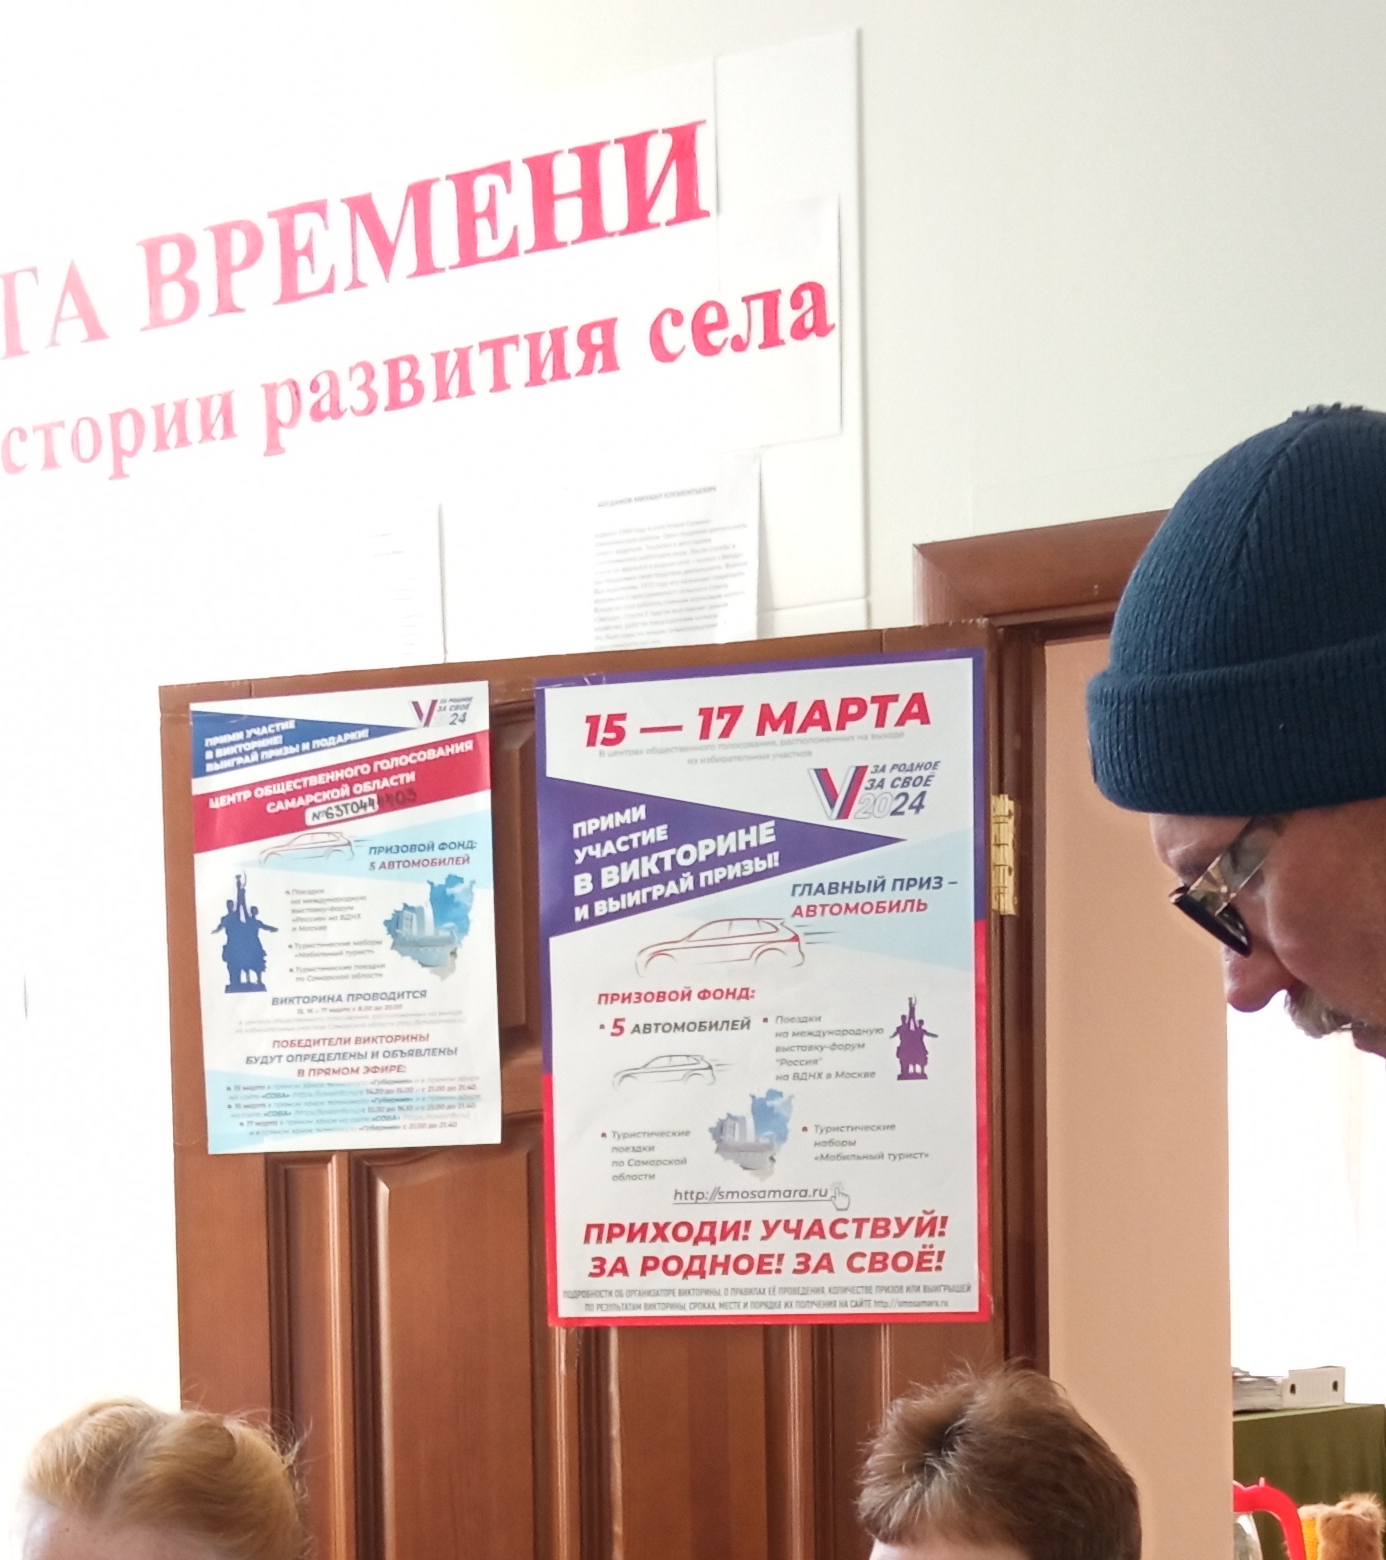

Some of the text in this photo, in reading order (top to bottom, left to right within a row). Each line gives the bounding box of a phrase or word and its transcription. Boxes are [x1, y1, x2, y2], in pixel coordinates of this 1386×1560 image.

[135, 118, 712, 334] ВРЕМЕНИ
[261, 314, 621, 457] развития
[647, 279, 838, 365] села
[585, 691, 931, 748] 15 17 МАРТА
[204, 719, 296, 748] ПРИМИ УЧАСТИЕ
[205, 735, 283, 761] В ВИКТОРИНЕ!
[205, 728, 369, 773] ВЫИГРАЙ ПРИЗЫ И ПОДАРКИ!
[645, 741, 716, 757] общественного
[780, 733, 856, 748] расположенных
[871, 730, 905, 742] выходе
[208, 740, 474, 810] ЦЕНТР ОБЩЕСТВЕННОГО ГОЛОСОВАНИЯ
[870, 760, 941, 775] ЗА РОДНОЕ
[864, 771, 935, 790] ЗА СВОЁ
[266, 787, 351, 814] САМАРСКОЙ
[352, 772, 416, 796] ОБЛАСТИ
[853, 791, 928, 820] 2024
[572, 804, 647, 839] ПРИМИ
[368, 840, 478, 856] ПРИЗОВОЙ ФОНД:
[573, 824, 668, 864] УЧАСТИЕ
[369, 853, 470, 871] 5 АВТОМОБИЛЕЙ
[573, 820, 777, 896] В ВИКТОРИНЕ
[574, 851, 781, 923] И ВЫИГРАЙ ПРИЗЫ!
[790, 875, 943, 898] ГЛАВНЫЙ ПРИЗ
[791, 899, 928, 919] АВТОМОБИЛЬ
[271, 990, 427, 1006] ВИКТОРИНА ПРОВОДИТСЯ
[597, 986, 756, 1005] ПРИЗОВОЙ ФОНД:
[609, 1016, 751, 1038] 5 АВТОМОБИЛЕЙ
[775, 1014, 822, 1024] Поездки
[272, 1033, 430, 1049] ПОБЕДИТЕЛИ ВИКТОРИНЫ
[791, 1026, 884, 1039] международную
[245, 1047, 458, 1066] БУДУТ ОПРЕДЕЛЕНЫ И ОБЪЯВЛЕНЫ
[775, 1042, 866, 1053] выставку-форум
[297, 1064, 407, 1078] В ПРЯМОМ ЭФИРЕ:
[775, 1073, 790, 1082] на
[792, 1071, 823, 1082] ВДНХ
[835, 1070, 876, 1080] Москве
[611, 1128, 691, 1140] Туристические
[814, 1122, 897, 1135] Туристические
[611, 1144, 655, 1154] поездки
[814, 1137, 857, 1148] наборы
[611, 1156, 687, 1168] по Самарской
[814, 1152, 885, 1163] «Мобильный
[611, 1171, 656, 1182] области
[673, 1186, 829, 1203] http://smosamara.ru
[583, 1209, 949, 1247] ПРИХОДИ! УЧАСТВУЙ!
[588, 1244, 946, 1281] ЗА РОДНОЕ! ЗА СВОЁ!
